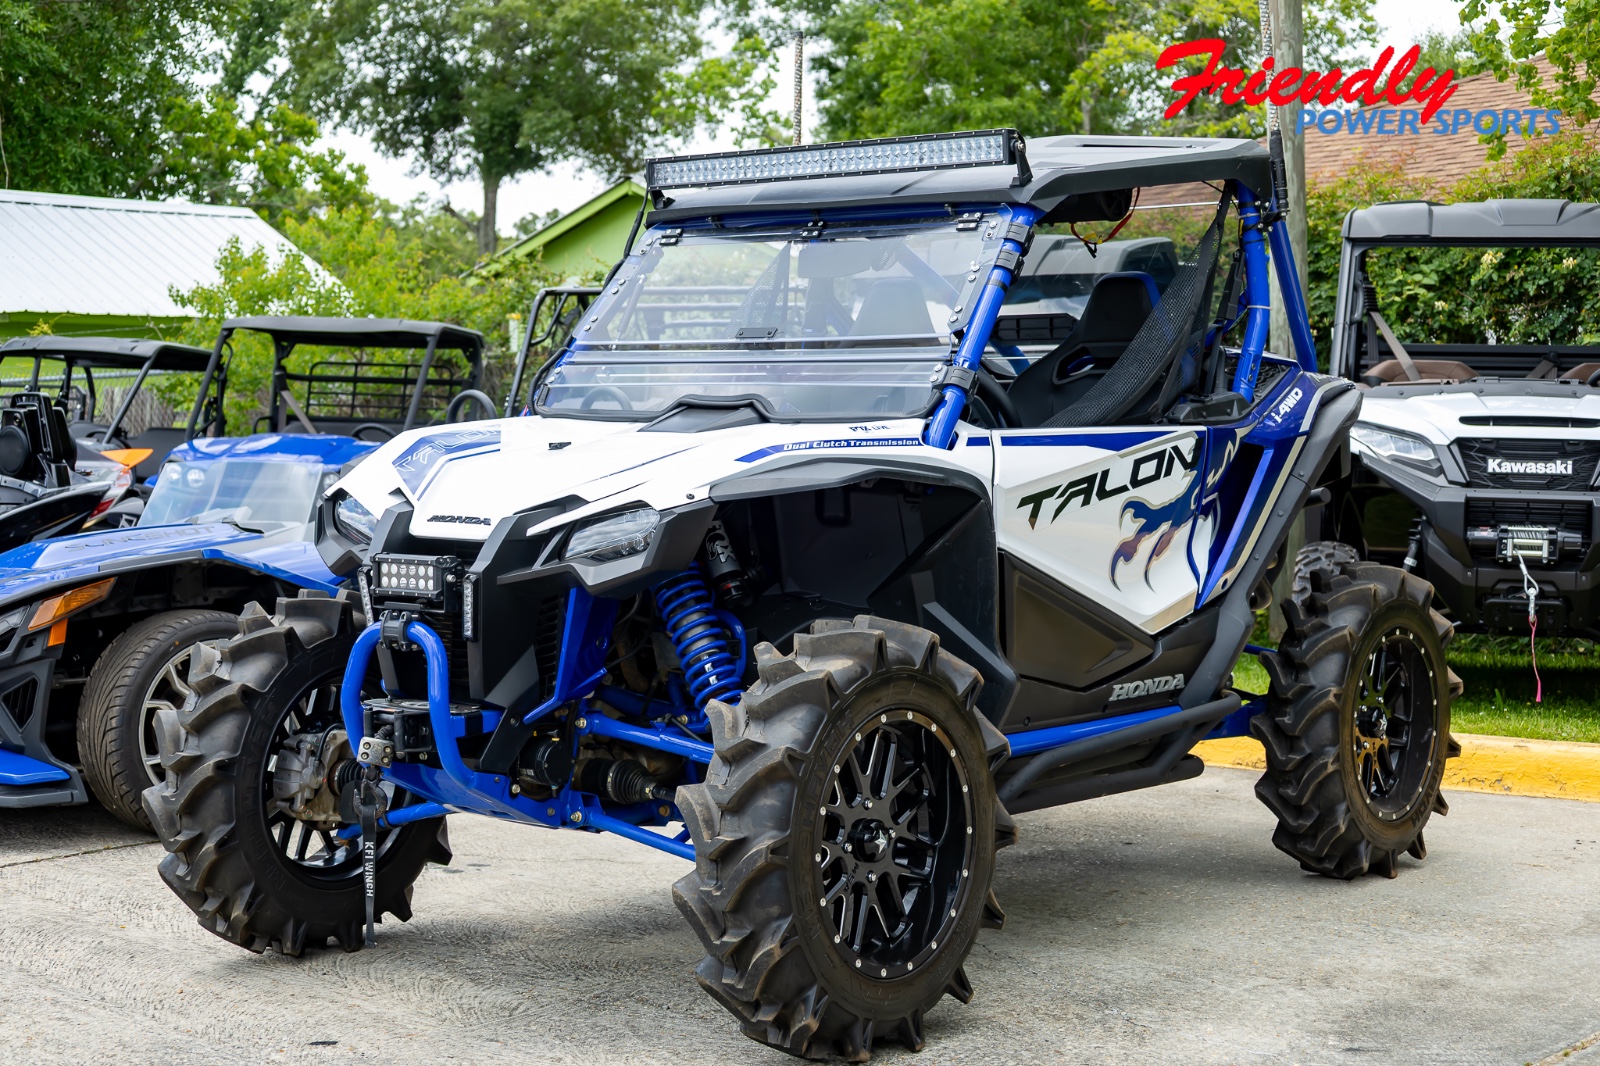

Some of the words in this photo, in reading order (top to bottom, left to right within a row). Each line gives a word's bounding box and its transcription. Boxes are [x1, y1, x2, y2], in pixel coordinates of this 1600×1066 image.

[783, 441, 810, 451] Dual
[813, 439, 847, 449] Clutch
[849, 438, 919, 447] Transmission
[1487, 458, 1573, 475] Kawasaki
[1016, 436, 1203, 531] TALON
[64, 525, 215, 553] SLINGSHOT
[1109, 673, 1185, 702] HONDA
[364, 842, 374, 859] KFI
[364, 861, 374, 896] WINCH
